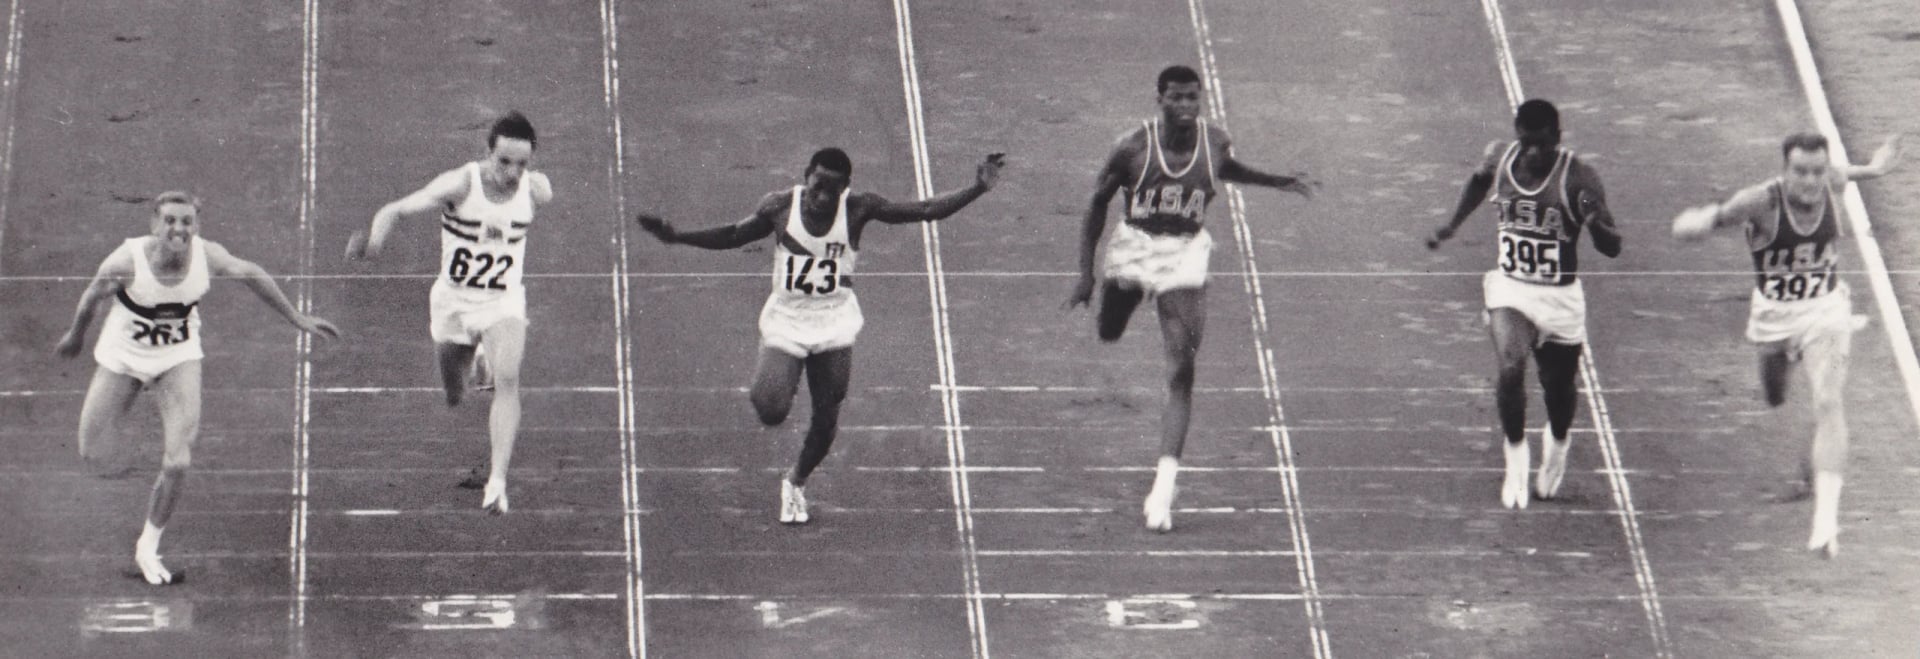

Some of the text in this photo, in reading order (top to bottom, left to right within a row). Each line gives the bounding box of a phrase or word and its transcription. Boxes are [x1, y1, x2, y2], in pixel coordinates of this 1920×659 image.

[449, 247, 514, 291] 622
[785, 255, 837, 295] 143
[1501, 236, 1558, 279] 395
[1765, 272, 1826, 301] 397
[131, 319, 189, 346] 263
